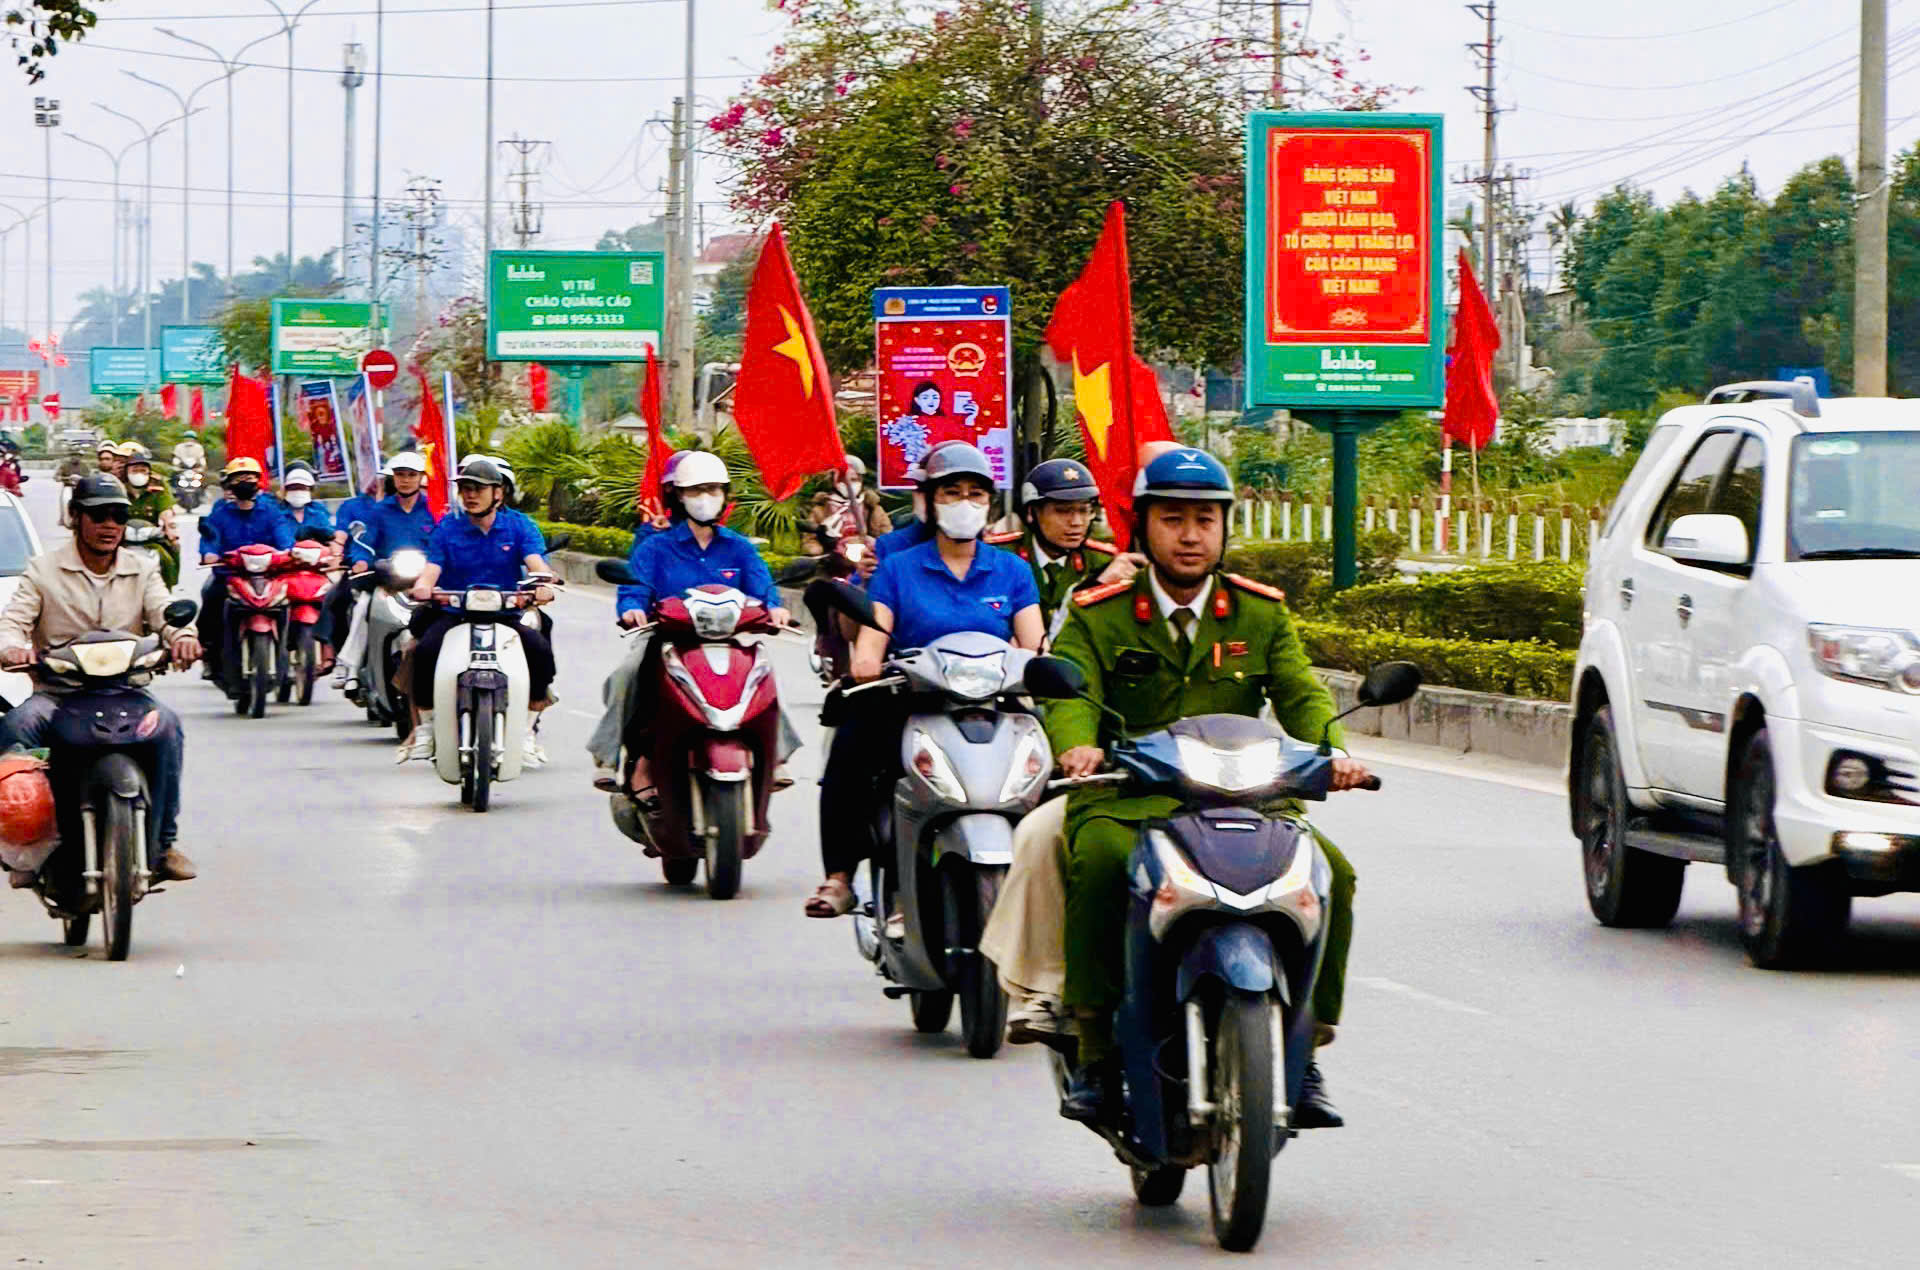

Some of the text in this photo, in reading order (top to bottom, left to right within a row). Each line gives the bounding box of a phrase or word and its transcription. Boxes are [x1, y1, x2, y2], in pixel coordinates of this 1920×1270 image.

[1324, 187, 1348, 207] VIỆT
[561, 278, 596, 293] VỊ TRÍ
[1322, 276, 1346, 296] VIỆT
[525, 293, 632, 308] CHÀO QUẢNG CÁO
[571, 314, 593, 325] 956
[594, 314, 625, 325] 3333
